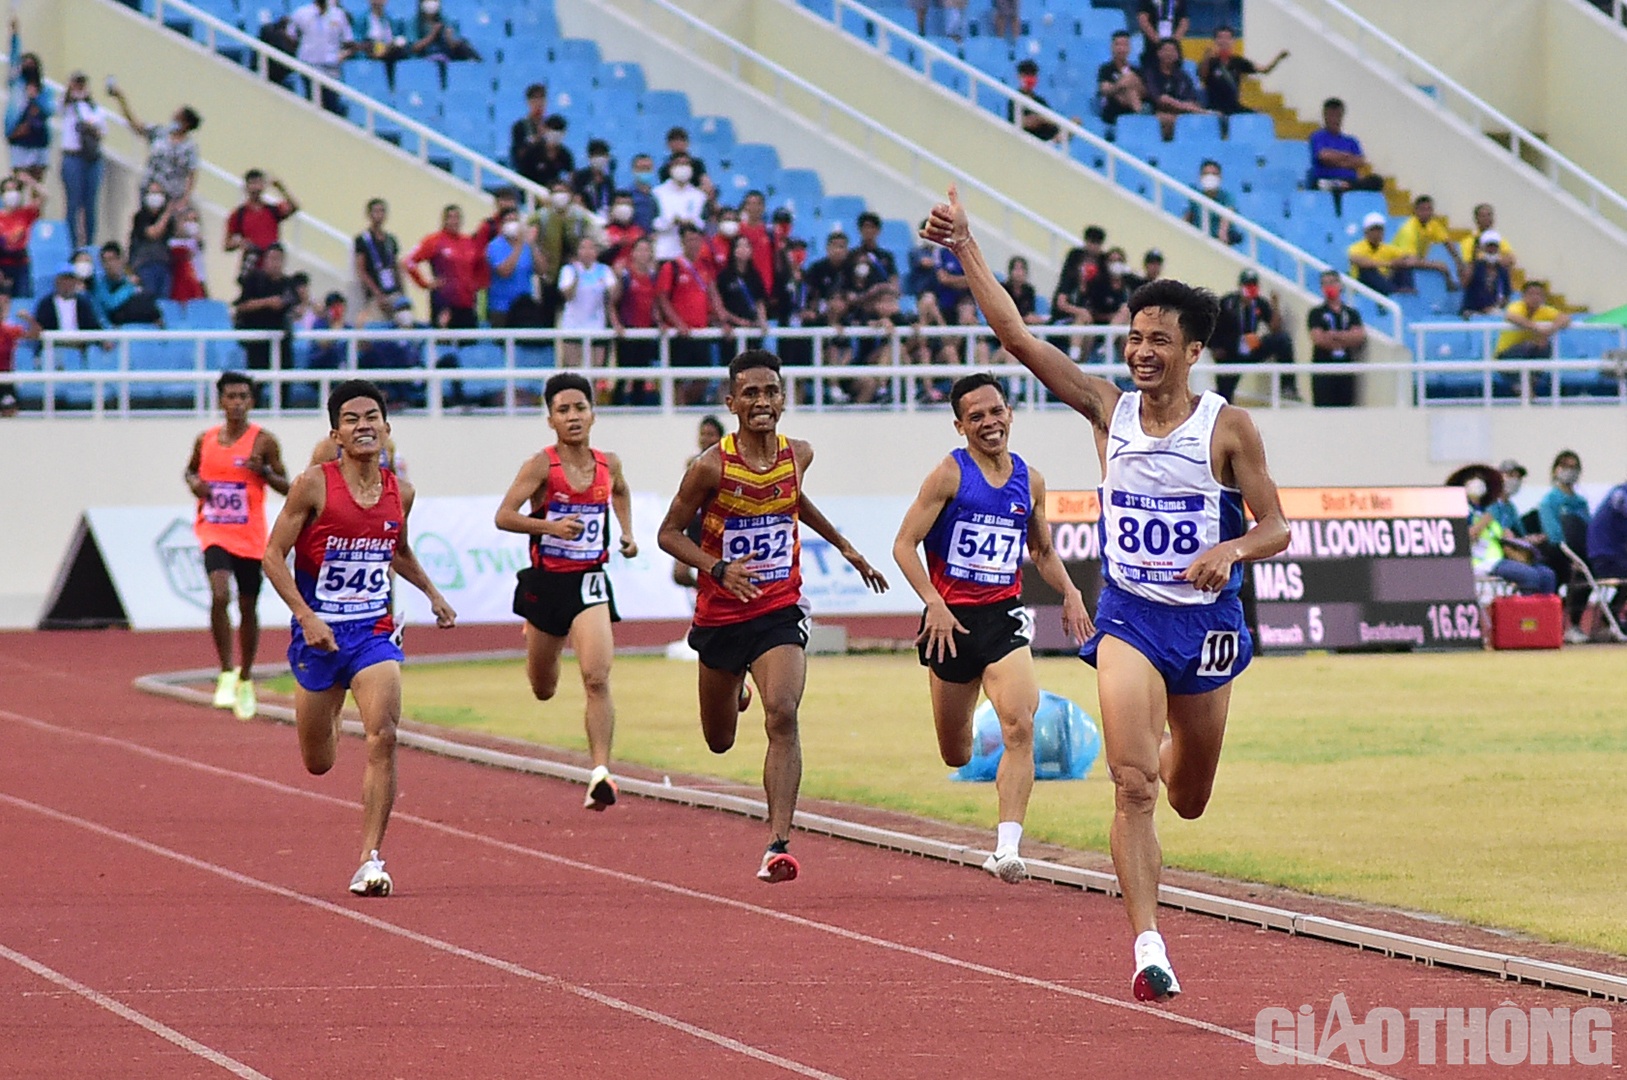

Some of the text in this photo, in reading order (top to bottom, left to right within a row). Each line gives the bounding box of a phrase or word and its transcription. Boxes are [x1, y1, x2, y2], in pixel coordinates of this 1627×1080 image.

[1141, 496, 1156, 509] SEA
[1158, 499, 1186, 511] Games
[729, 530, 788, 561] 952
[957, 529, 1015, 563] 547
[1118, 516, 1199, 555] 808
[1313, 519, 1391, 556] LOONG
[1394, 519, 1455, 555] DENG
[325, 566, 384, 593] 549
[589, 575, 602, 599] 4
[1253, 563, 1304, 600] MAS
[1309, 606, 1324, 643] 5
[1428, 604, 1480, 640] 16.62
[1205, 634, 1234, 672] 10
